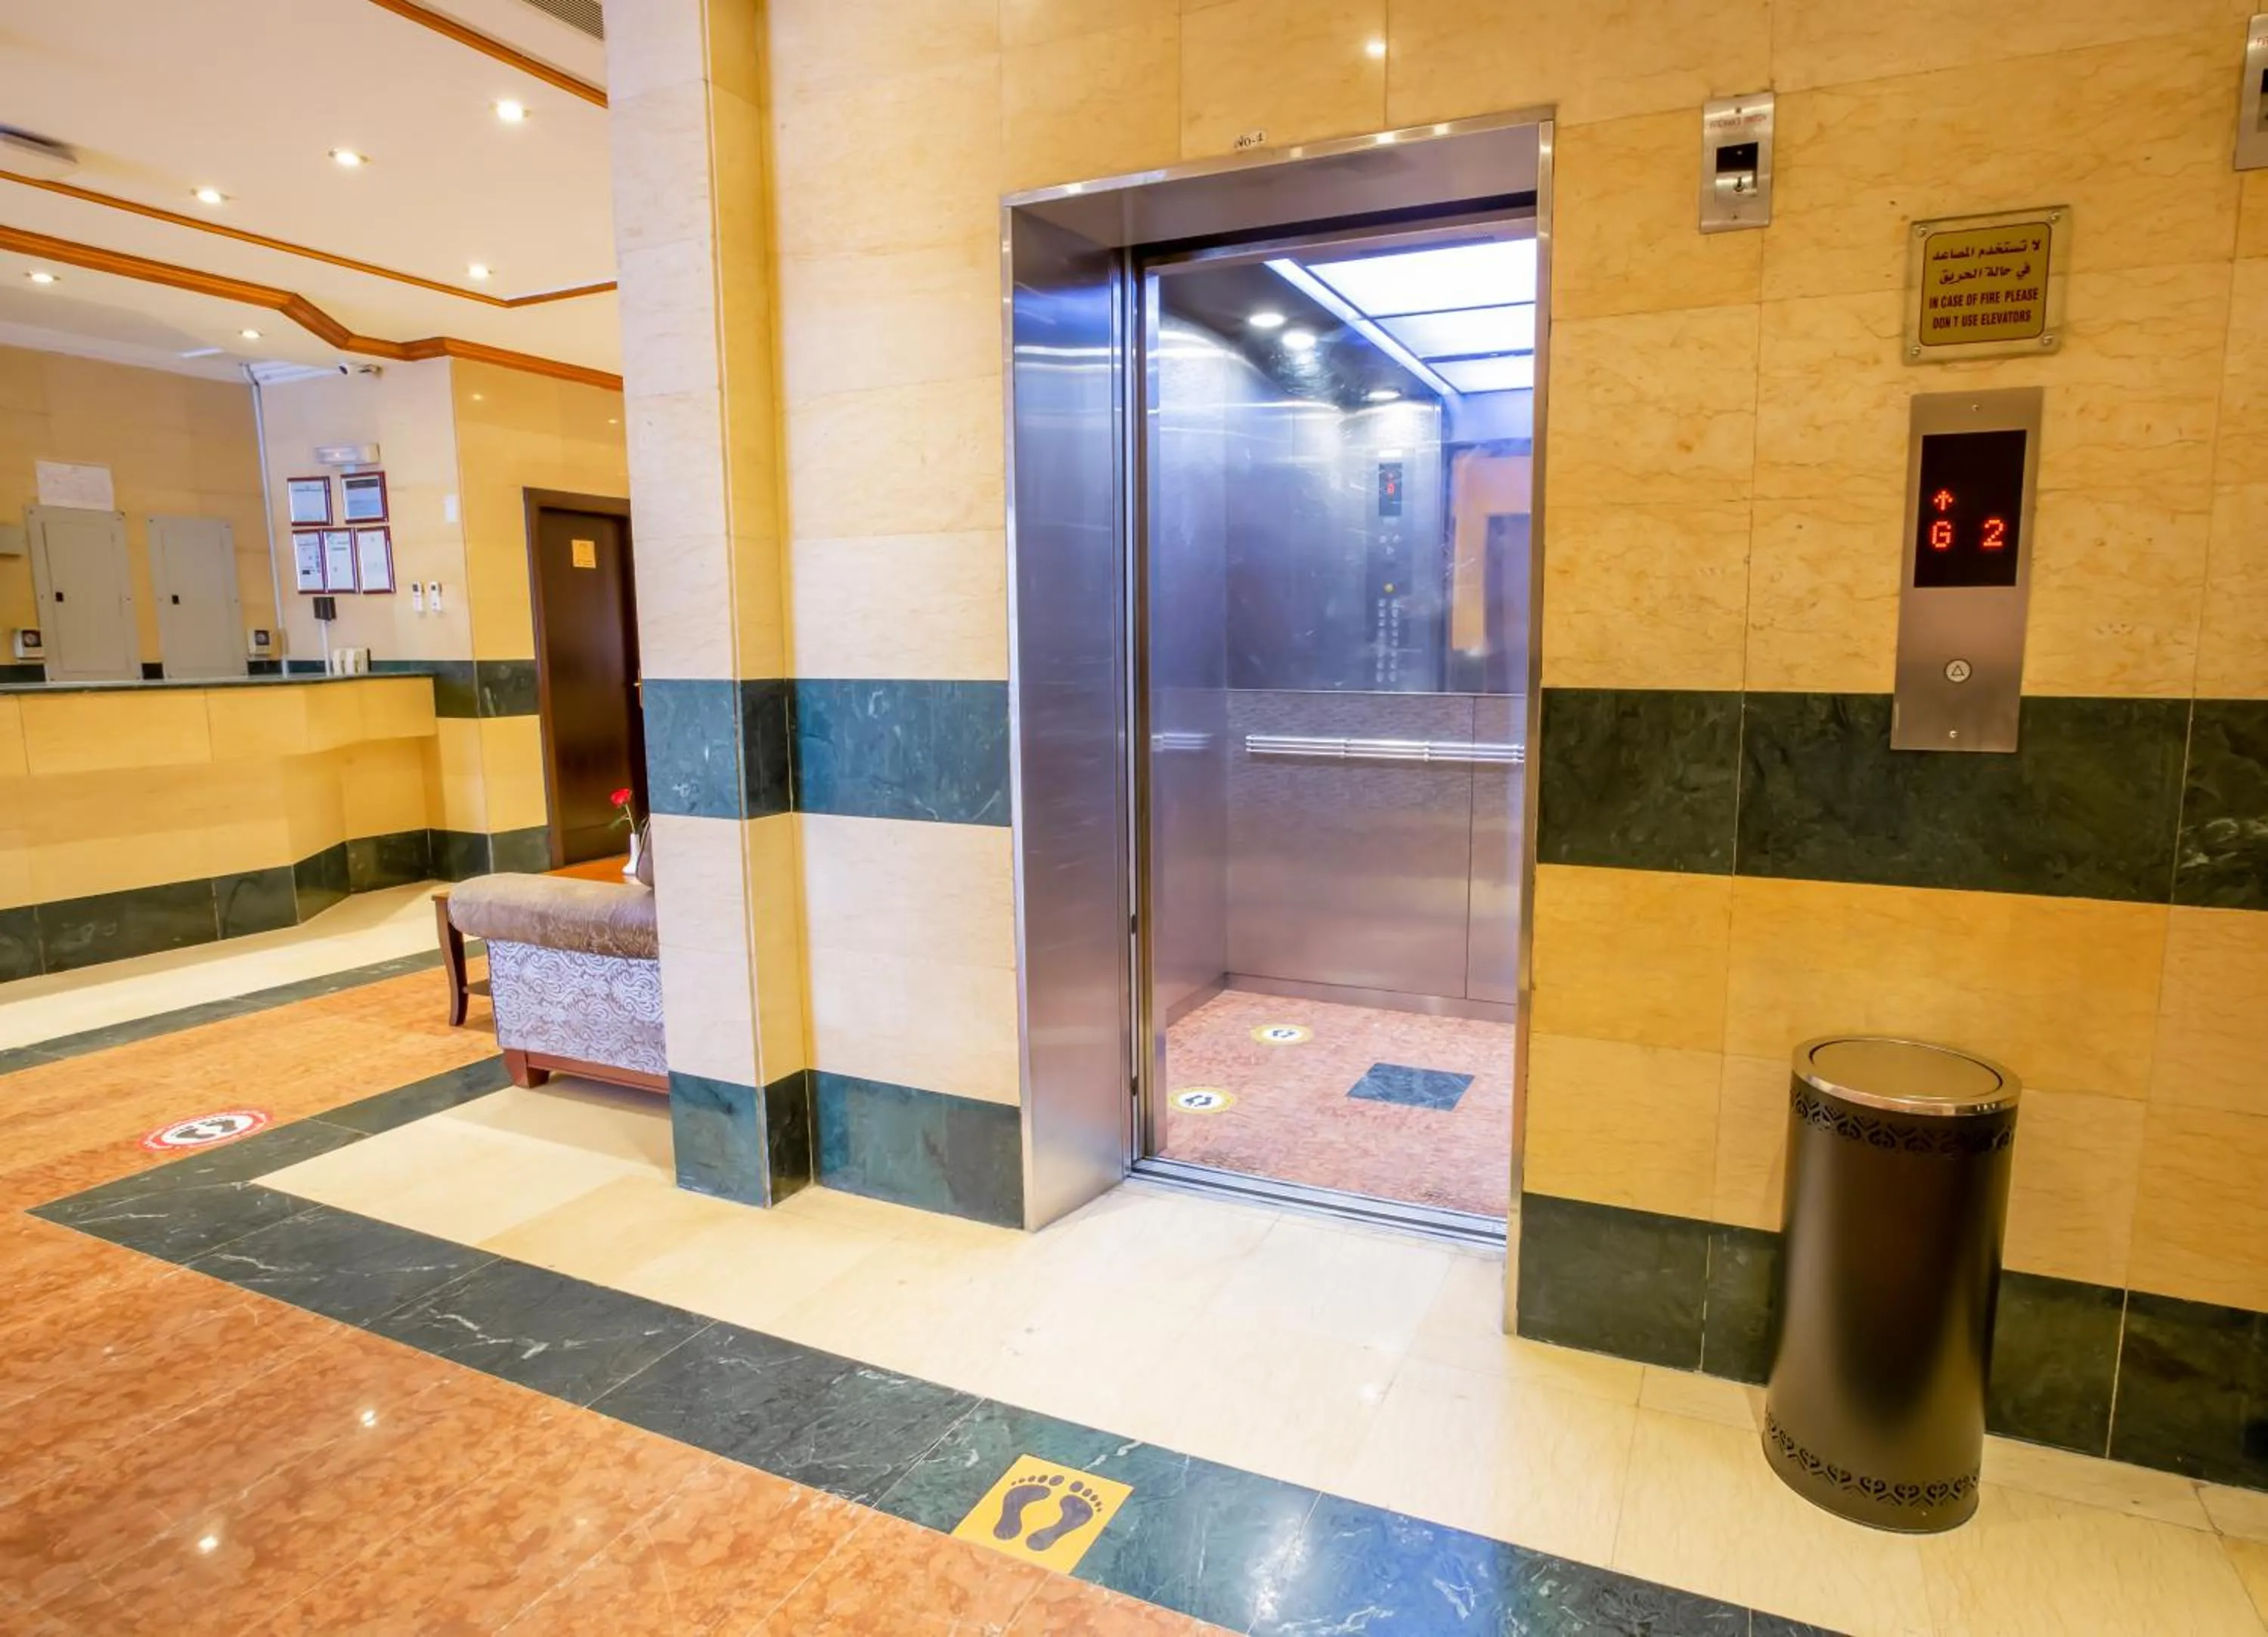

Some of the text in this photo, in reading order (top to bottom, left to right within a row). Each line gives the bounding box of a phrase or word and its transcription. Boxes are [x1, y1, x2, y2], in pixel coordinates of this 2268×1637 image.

[1932, 239, 2041, 261] لا تستخدم المصاعد
[1938, 261, 2031, 285] في حالة الحريق
[1929, 287, 2040, 310] IN CASE OF FIRE PLEASE
[1961, 314, 1978, 327] USE
[1981, 309, 2032, 326] ELEVATORS
[1931, 518, 2004, 548] G 2
